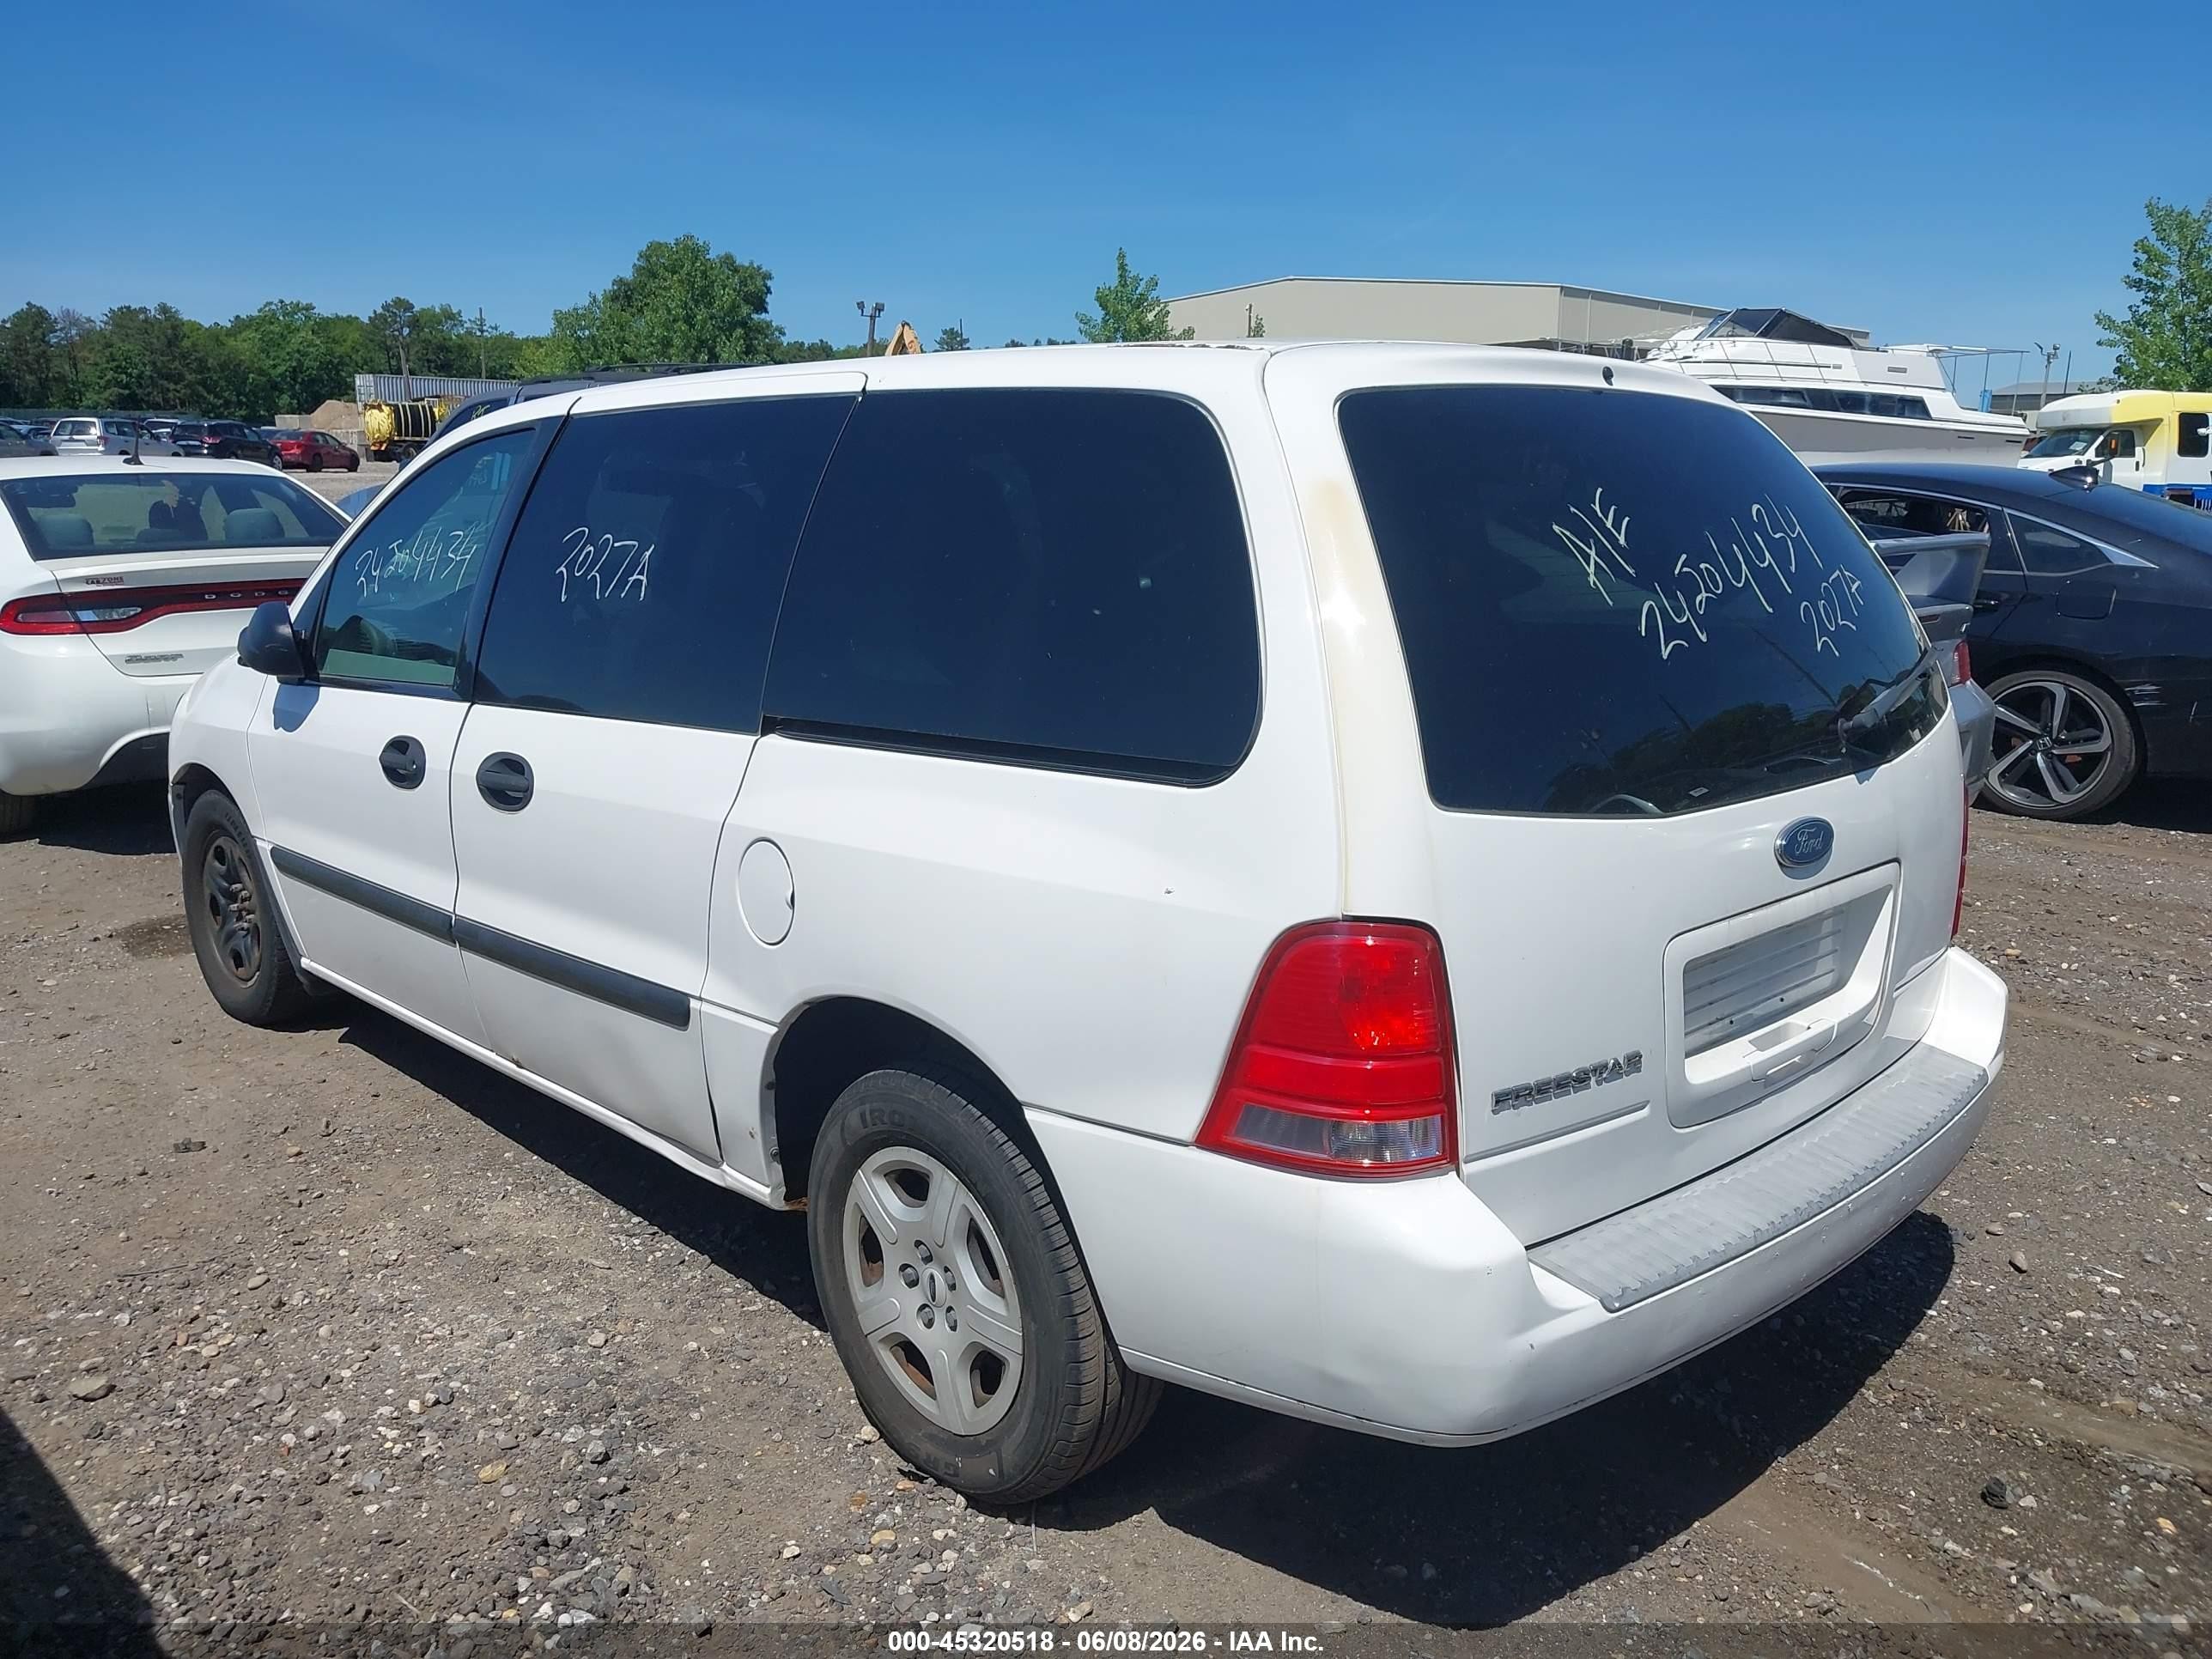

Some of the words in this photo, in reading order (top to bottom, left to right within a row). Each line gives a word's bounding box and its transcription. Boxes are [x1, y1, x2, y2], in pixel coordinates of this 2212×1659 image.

[204, 590, 289, 599] DODG
[556, 527, 654, 603] 2027A
[1801, 564, 1864, 657] 2027A
[1794, 827, 1824, 854] Ford
[1491, 1050, 1643, 1113] FREESTAR
